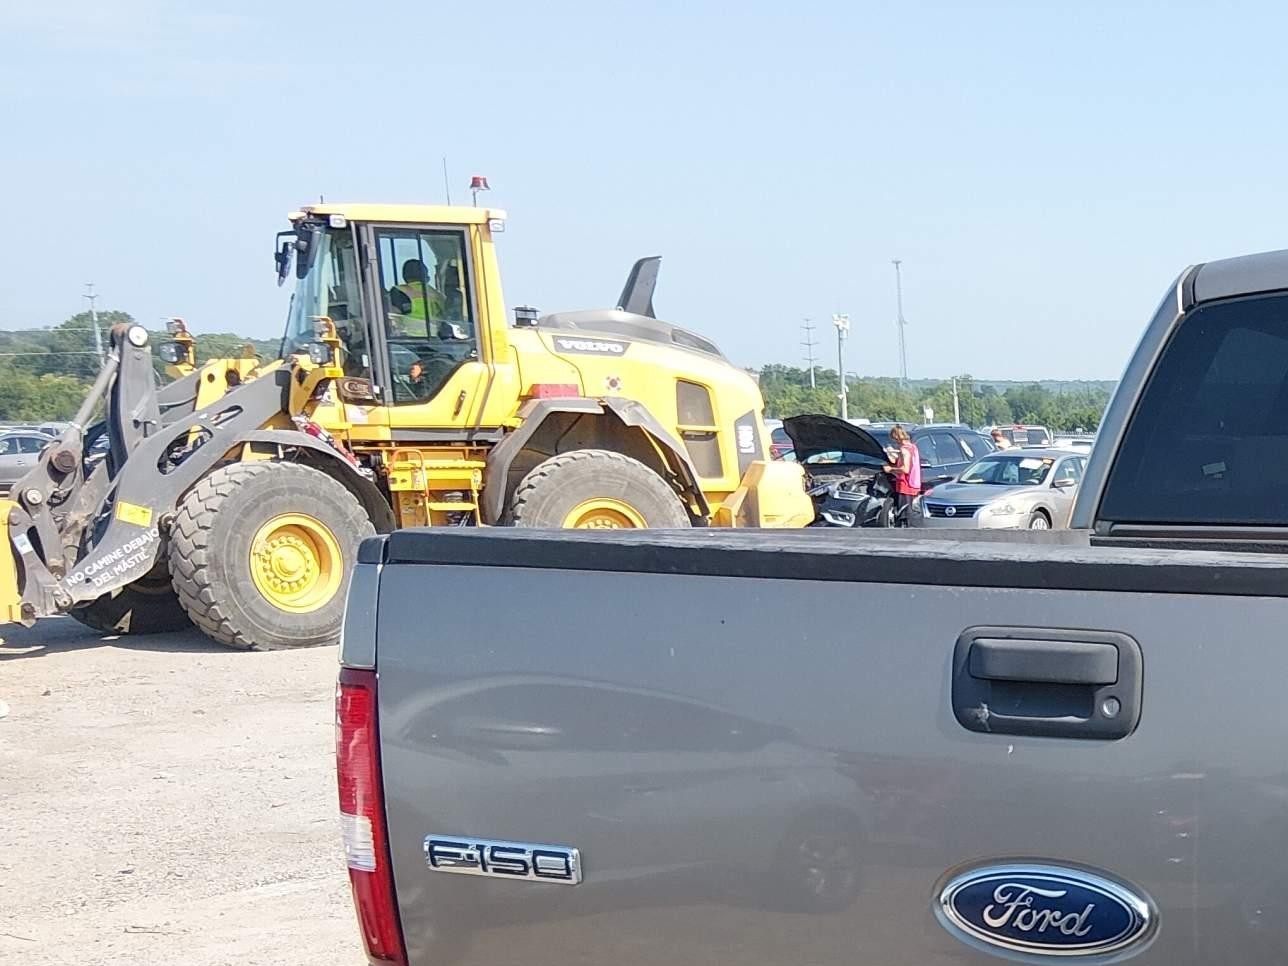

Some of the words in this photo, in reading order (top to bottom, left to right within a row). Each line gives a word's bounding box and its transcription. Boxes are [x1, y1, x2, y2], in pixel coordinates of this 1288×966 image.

[557, 339, 624, 353] VOLVO
[66, 571, 85, 587] NO
[84, 548, 124, 576] CAMINE
[122, 528, 160, 554] DEBAJO
[92, 571, 113, 587] DEL
[983, 883, 1096, 937] Ford
